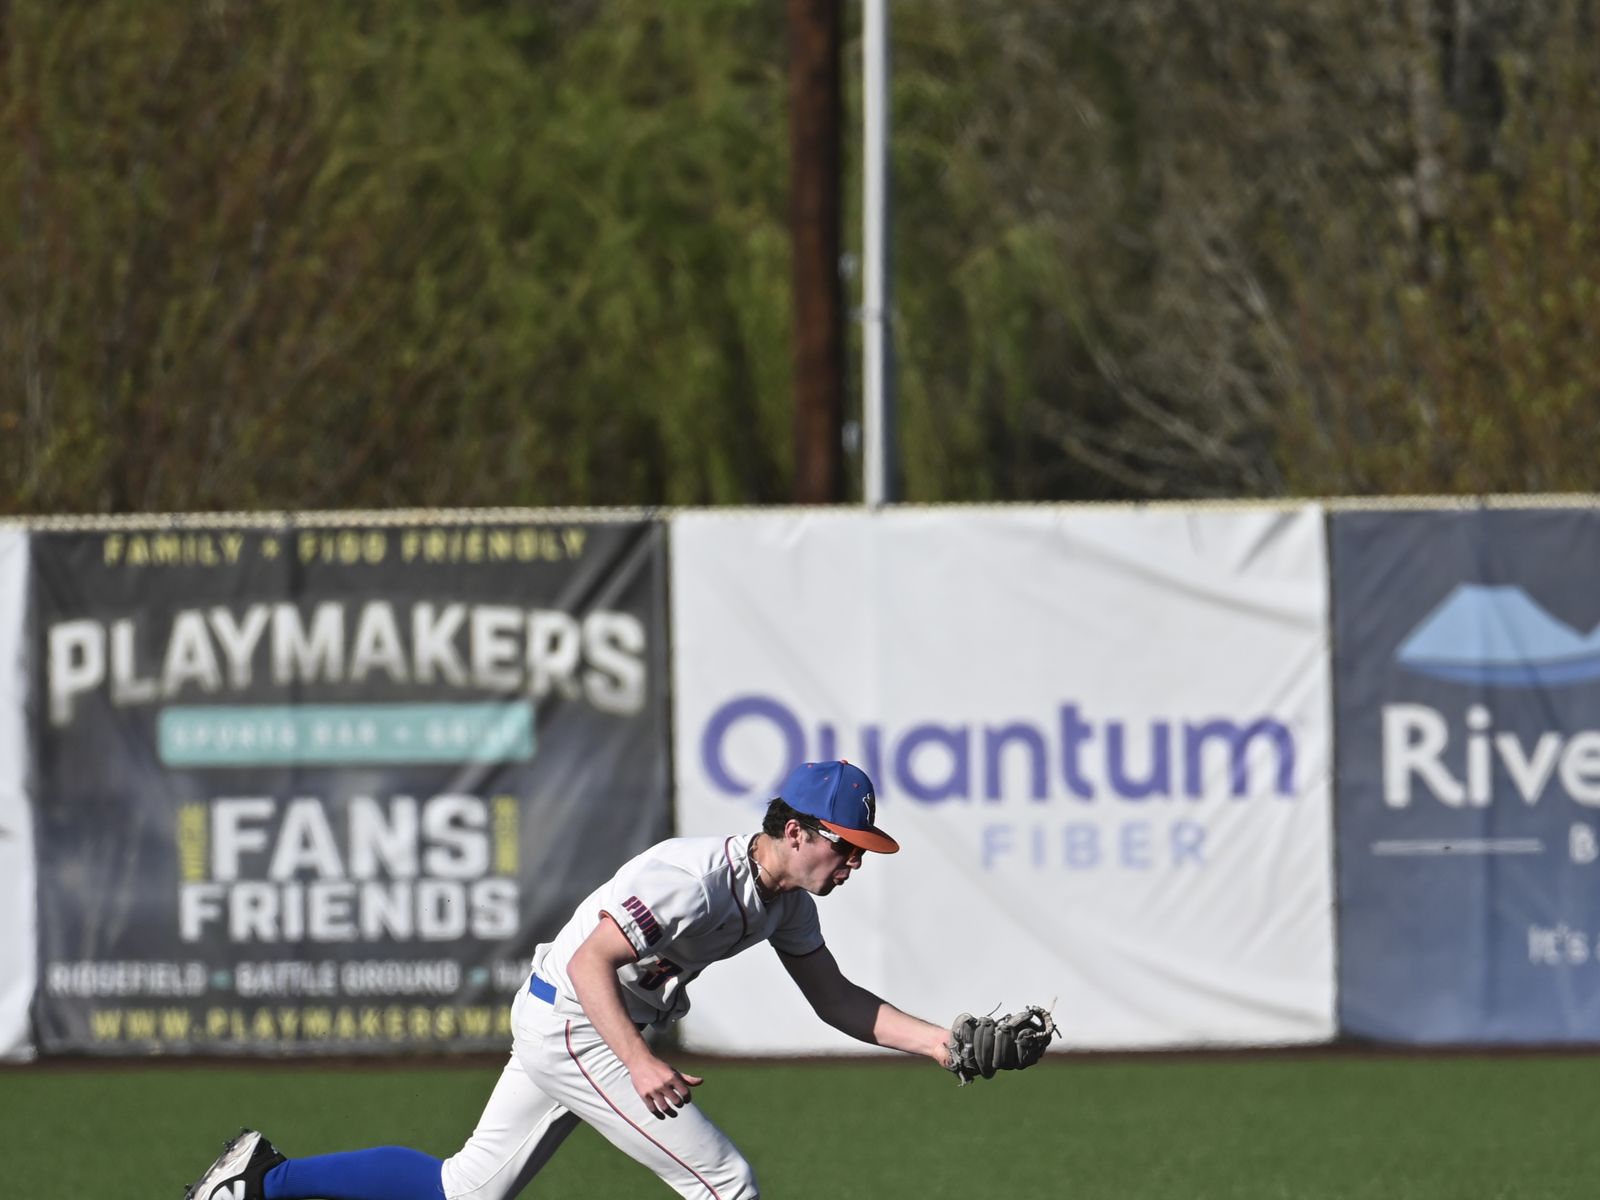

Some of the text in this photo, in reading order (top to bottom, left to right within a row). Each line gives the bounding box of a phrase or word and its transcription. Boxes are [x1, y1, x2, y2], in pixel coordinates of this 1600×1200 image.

[401, 528, 587, 564] FRIENDLY
[48, 600, 646, 727] PLAYMAKERS
[701, 694, 1297, 804] Quantum
[211, 792, 491, 884] FANS
[981, 822, 1210, 872] FIBER
[178, 878, 521, 944] FRIENDS
[1528, 924, 1589, 965] It's
